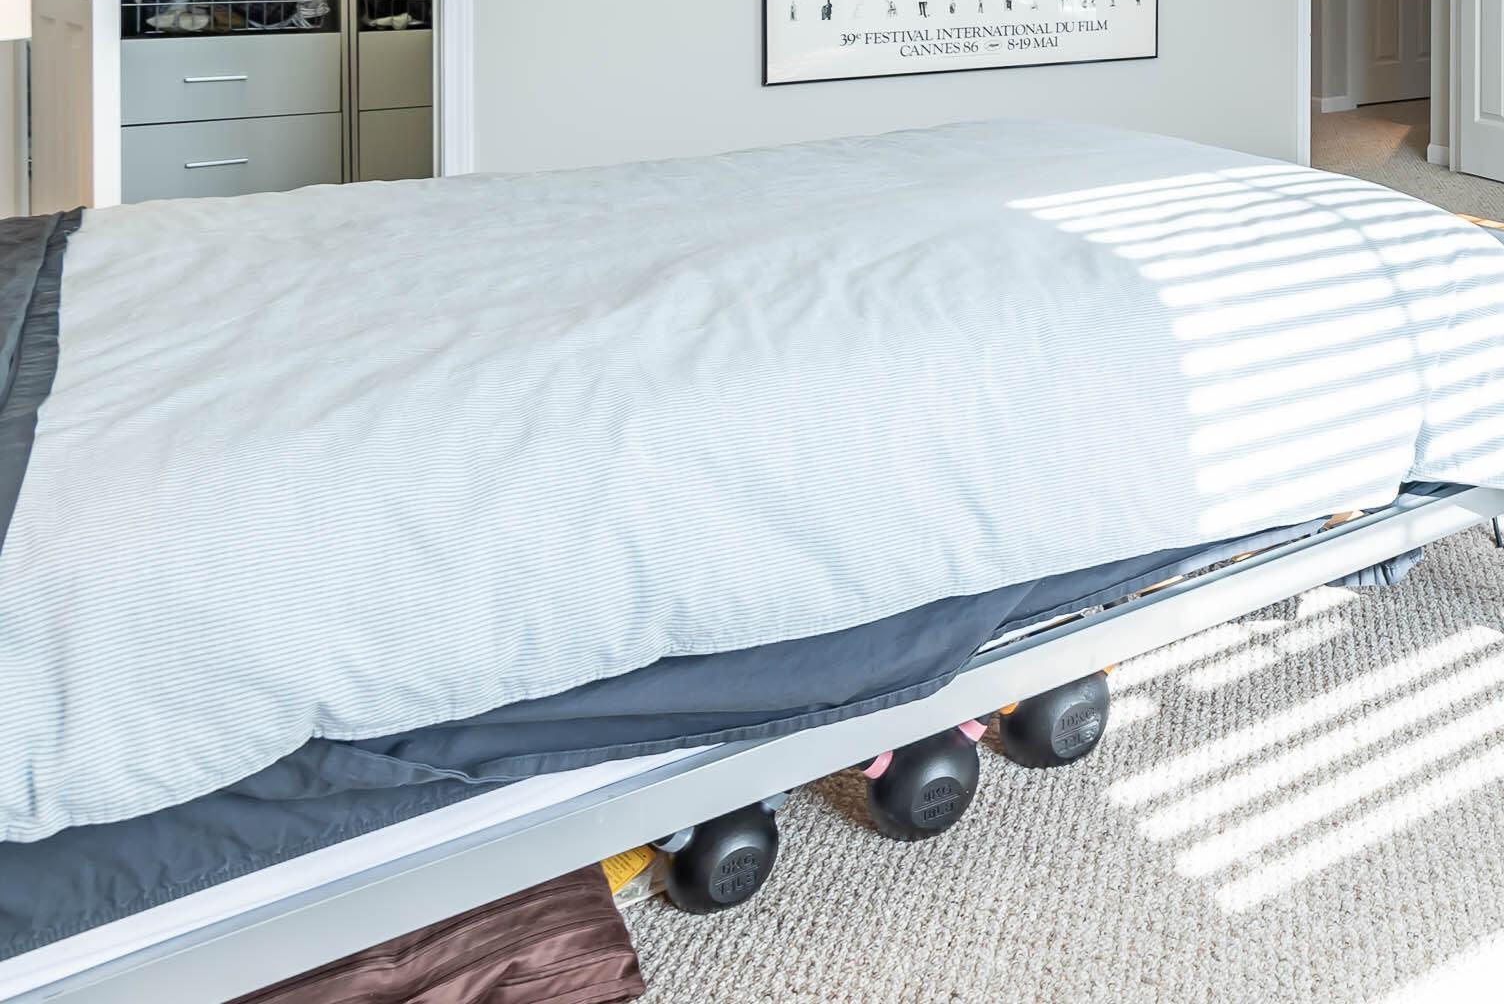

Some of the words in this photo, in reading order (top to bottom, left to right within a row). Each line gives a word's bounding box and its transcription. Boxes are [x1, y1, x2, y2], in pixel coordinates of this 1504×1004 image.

[864, 29, 933, 45] FESTIVAL
[936, 23, 1052, 40] INTERNATIONAL
[1055, 21, 1074, 34] DU
[1078, 19, 1108, 32] FILM
[900, 41, 960, 57] CANNES
[962, 40, 979, 53] 86
[1007, 37, 1031, 51] 8-19
[1033, 35, 1058, 49] MAI
